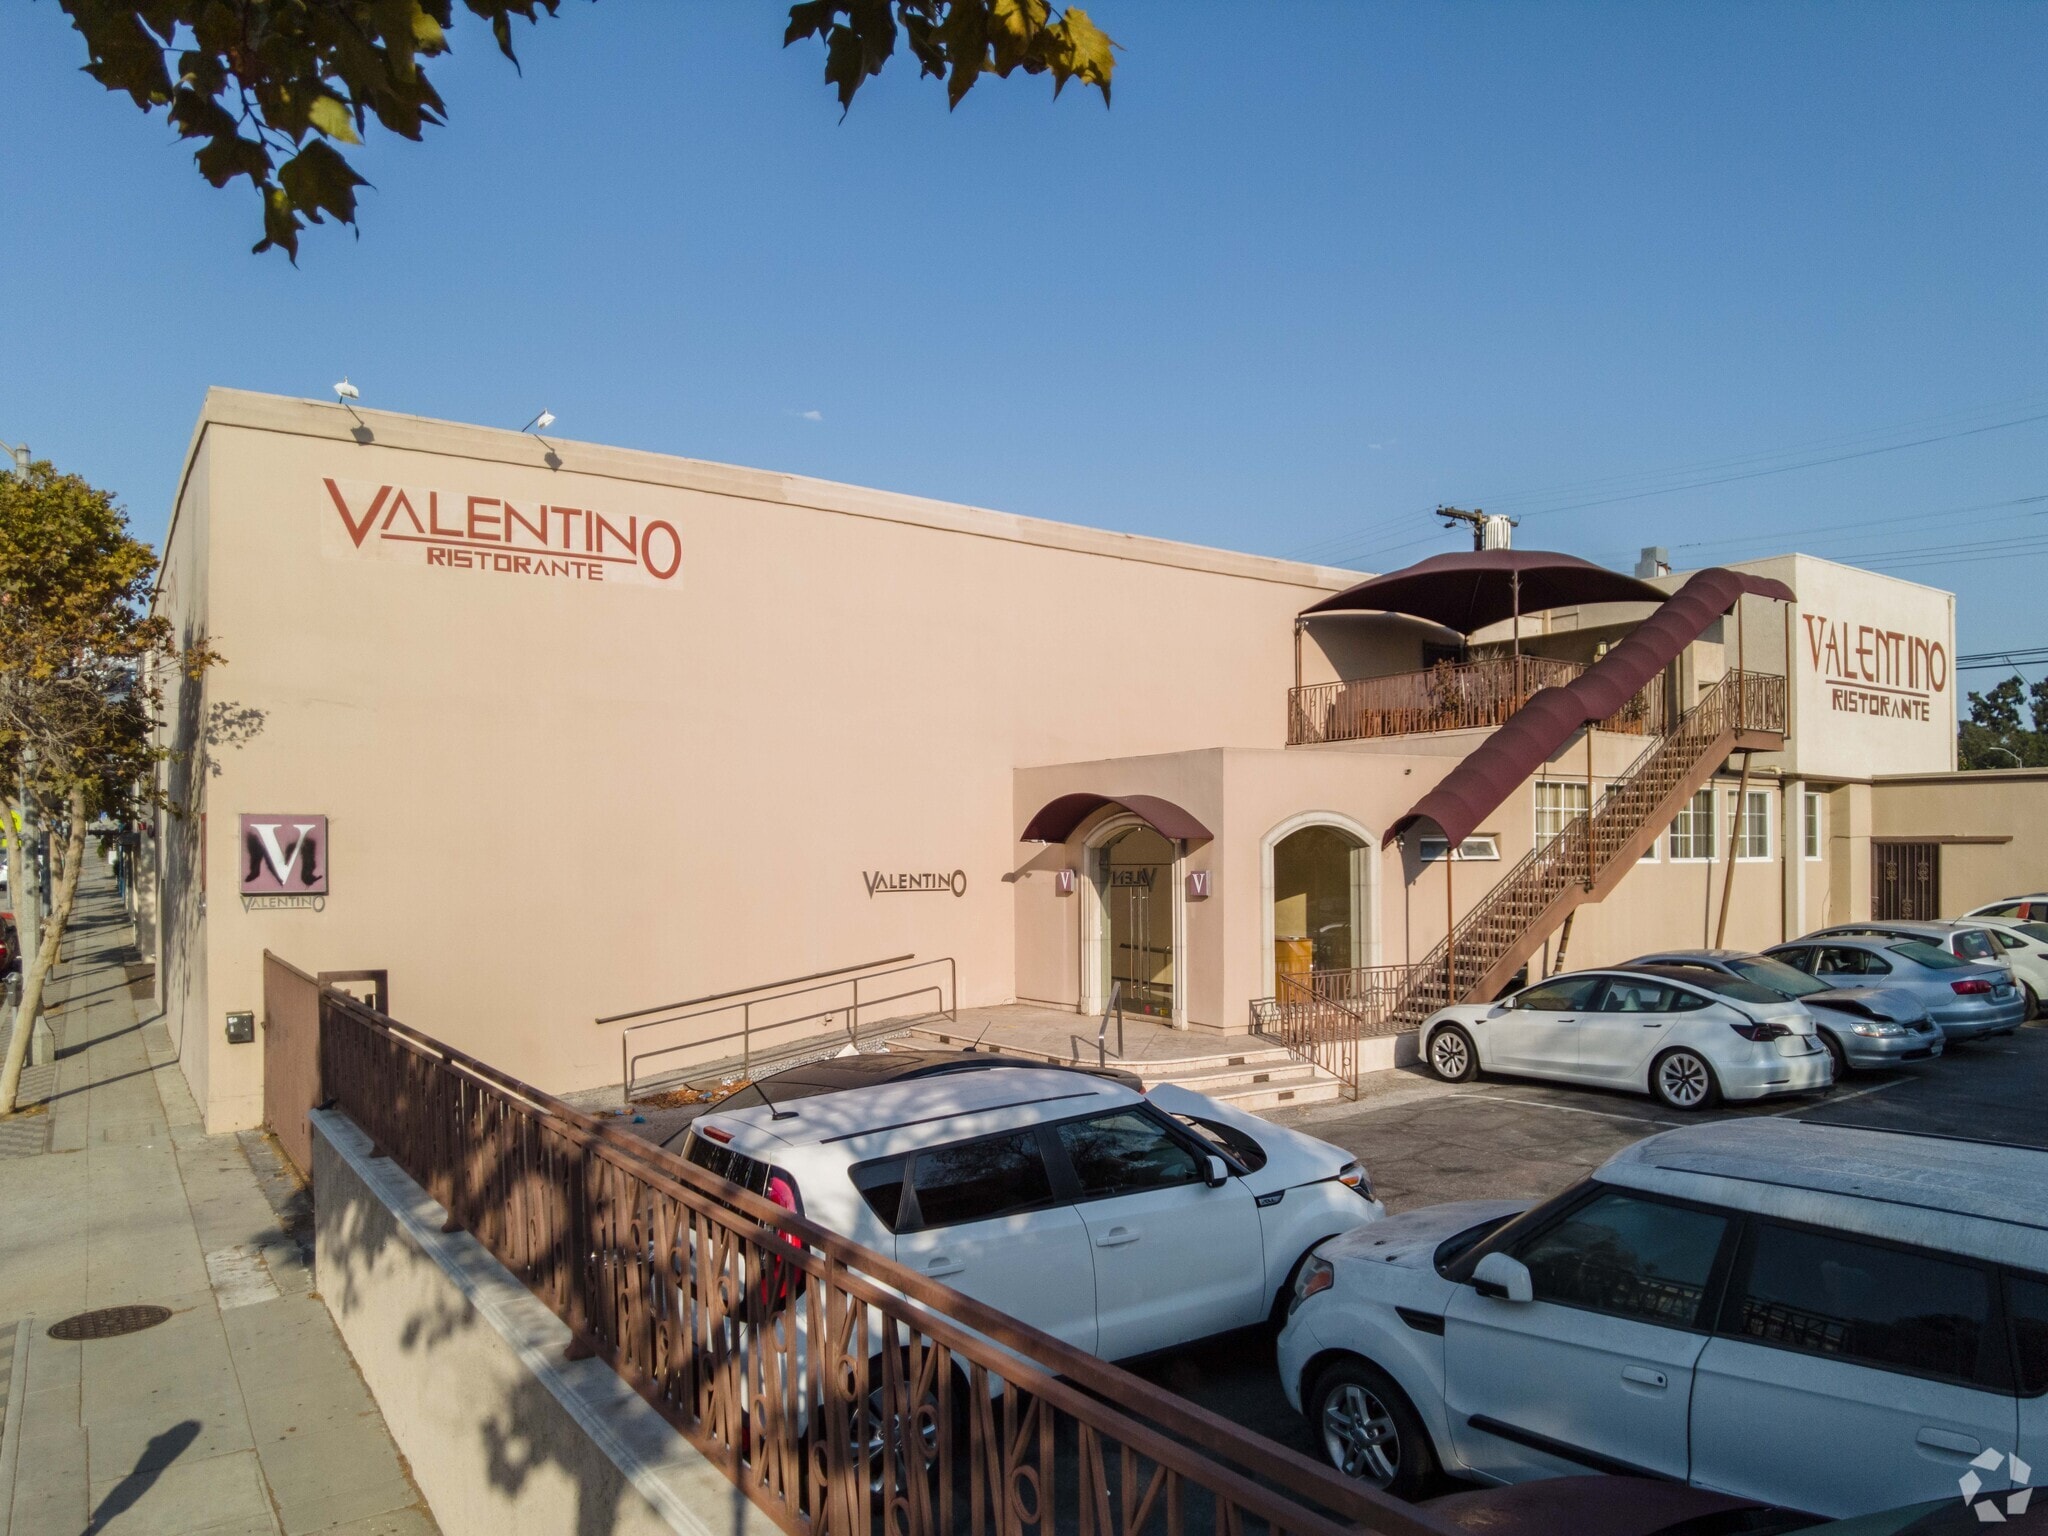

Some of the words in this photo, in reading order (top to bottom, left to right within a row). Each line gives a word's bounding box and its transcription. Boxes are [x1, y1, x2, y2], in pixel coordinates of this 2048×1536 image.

[322, 478, 682, 580] VALENTINO
[427, 547, 603, 581] RISTORANTE
[1802, 613, 1947, 693] VALENTINO
[1832, 688, 1930, 722] RISTORANTE
[862, 869, 967, 899] VALENTINO
[1060, 872, 1070, 890] V
[1192, 873, 1205, 894] V
[240, 895, 326, 914] VALENTINO
